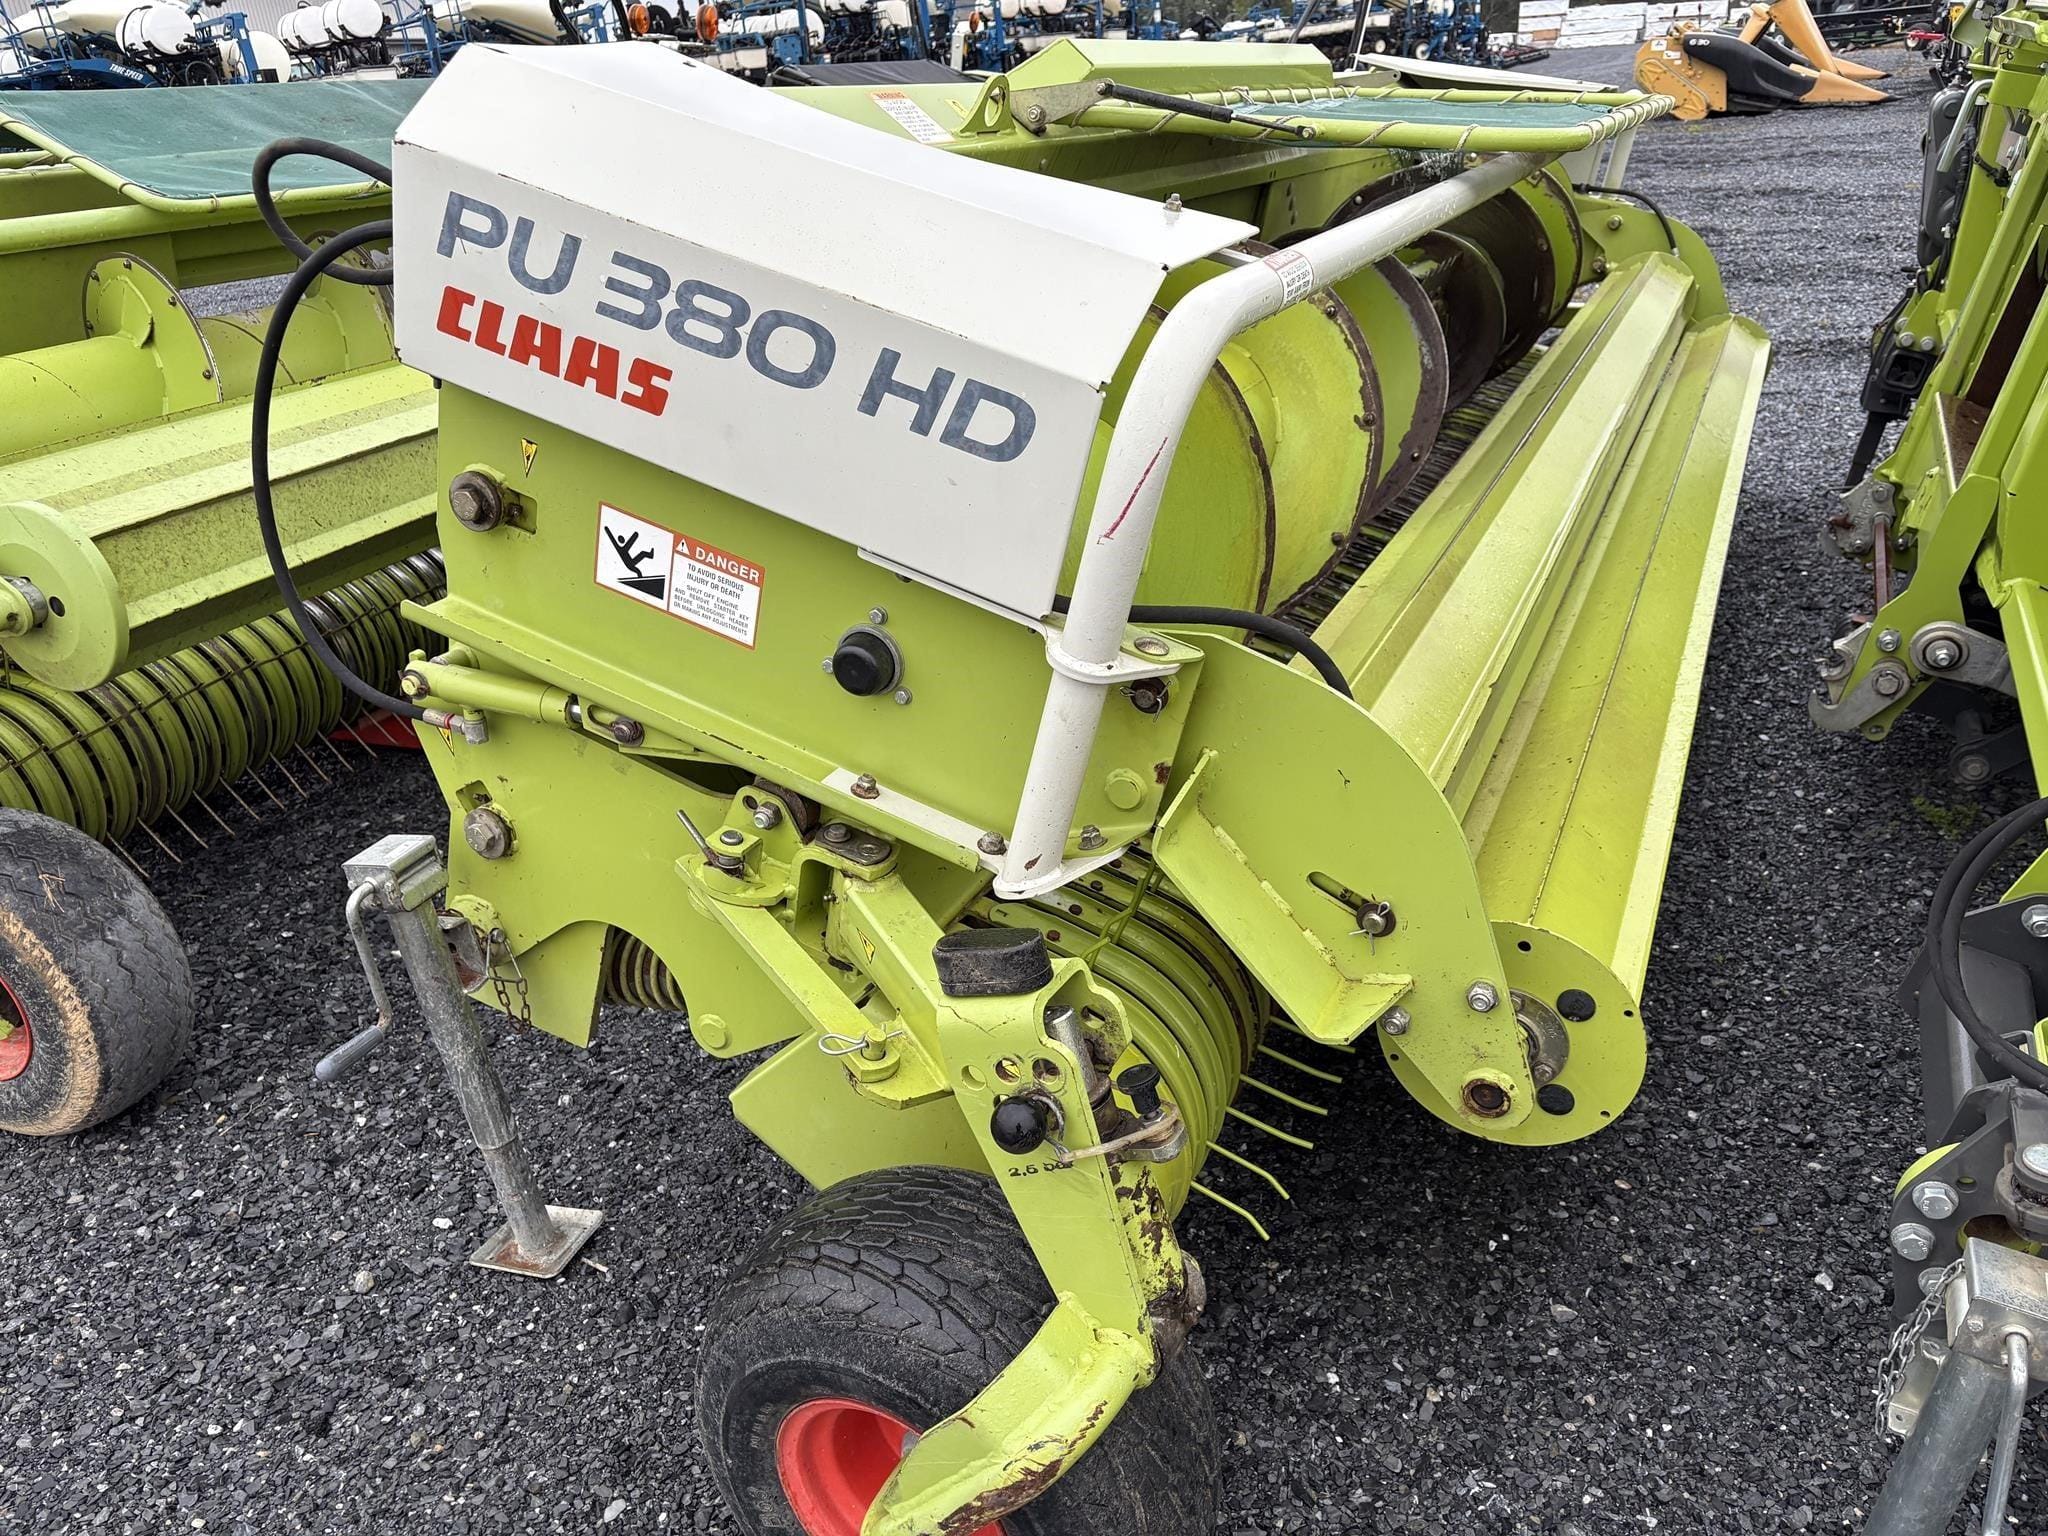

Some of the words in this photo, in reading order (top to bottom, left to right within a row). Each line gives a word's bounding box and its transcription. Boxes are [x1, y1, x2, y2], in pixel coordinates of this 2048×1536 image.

[109, 63, 126, 74] TRUE
[125, 69, 144, 80] SPEED
[436, 191, 582, 295] PU
[595, 250, 836, 389] 380
[857, 348, 1036, 462] HD
[436, 286, 673, 417] CLAAS
[695, 547, 759, 583] DANGER
[687, 573, 709, 586] INJURY
[710, 583, 719, 591] OR
[721, 586, 741, 599] DEATH
[697, 567, 716, 580] AVOID
[718, 576, 744, 591] SERIOUS
[674, 594, 693, 606] BEFORE
[729, 617, 748, 628] HEADER
[675, 587, 685, 595] AND
[689, 593, 709, 605] REMOVE
[714, 603, 736, 616] STARTER
[687, 585, 702, 595] SHUT
[704, 592, 715, 600] OFF
[717, 597, 738, 610] ENGINE
[713, 617, 747, 636] ADJUSTMENTS
